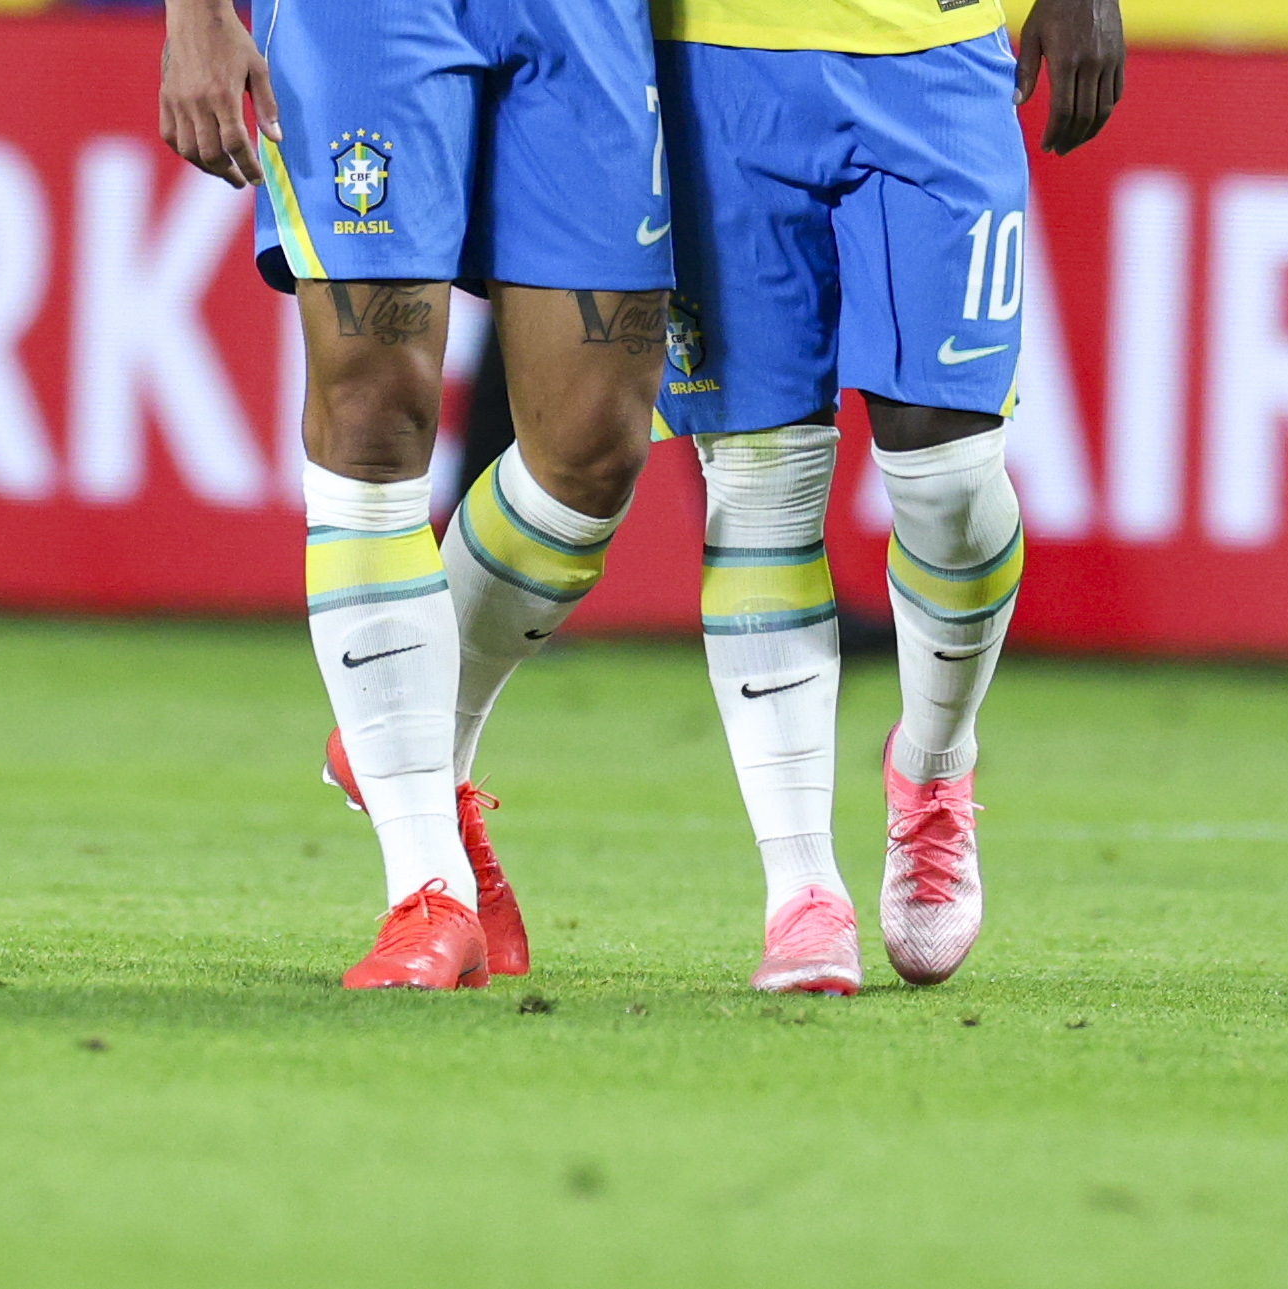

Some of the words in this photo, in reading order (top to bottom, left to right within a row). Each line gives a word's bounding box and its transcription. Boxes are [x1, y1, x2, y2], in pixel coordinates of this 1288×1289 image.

[645, 85, 664, 196] 7
[350, 173, 372, 182] CBF
[333, 220, 394, 234] BRASIL
[962, 209, 1024, 321] 10
[671, 334, 687, 344] CBF
[668, 379, 720, 395] BRASIL
